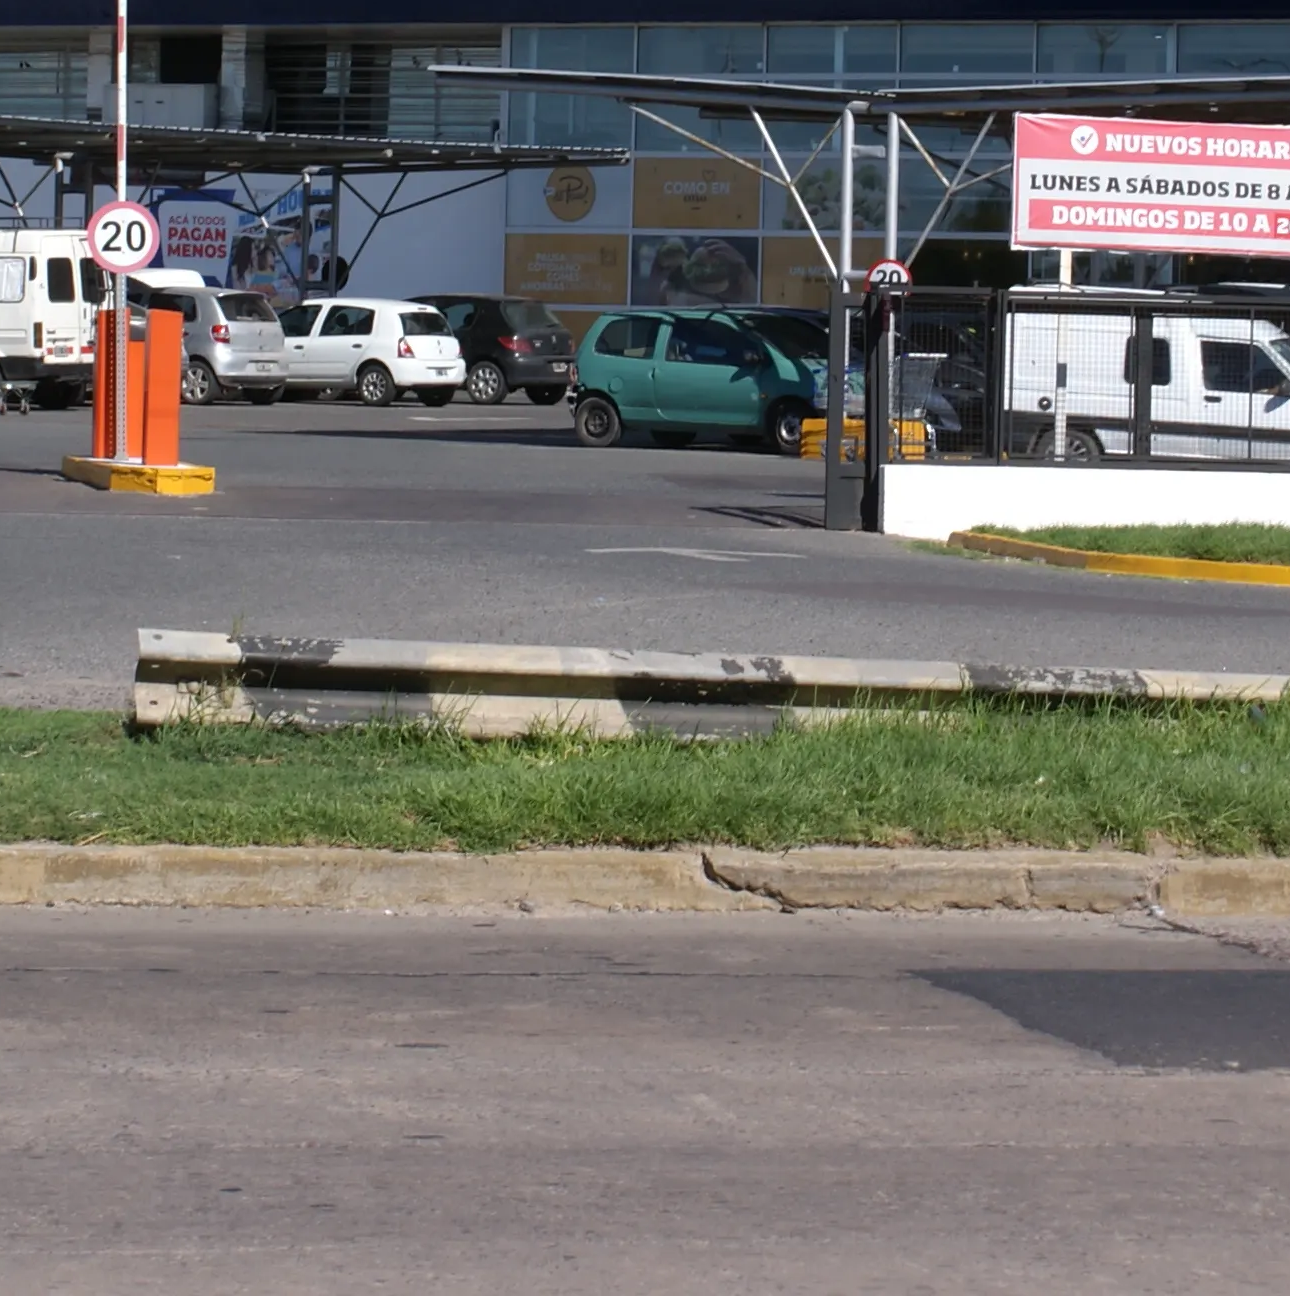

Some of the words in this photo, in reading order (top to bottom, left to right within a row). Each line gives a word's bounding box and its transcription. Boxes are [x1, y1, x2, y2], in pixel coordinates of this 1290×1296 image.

[1105, 132, 1202, 157] NUEVOS
[662, 180, 708, 195] COMO
[711, 180, 731, 195] EN
[1029, 174, 1101, 194] LUNES
[1105, 176, 1121, 194] A
[1126, 174, 1230, 199] SÁBADOS
[1234, 182, 1262, 200] DE
[1267, 183, 1281, 201] 8
[168, 212, 190, 226] ACÁ
[192, 215, 226, 226] TODOS
[1050, 205, 1179, 230] DOMINGOS
[1183, 211, 1215, 231] DE
[1219, 212, 1249, 233] 10
[1252, 213, 1271, 234] A
[100, 220, 147, 253] 20
[167, 227, 227, 242] PAGAN
[166, 244, 228, 259] MENOS
[876, 269, 902, 285] 20
